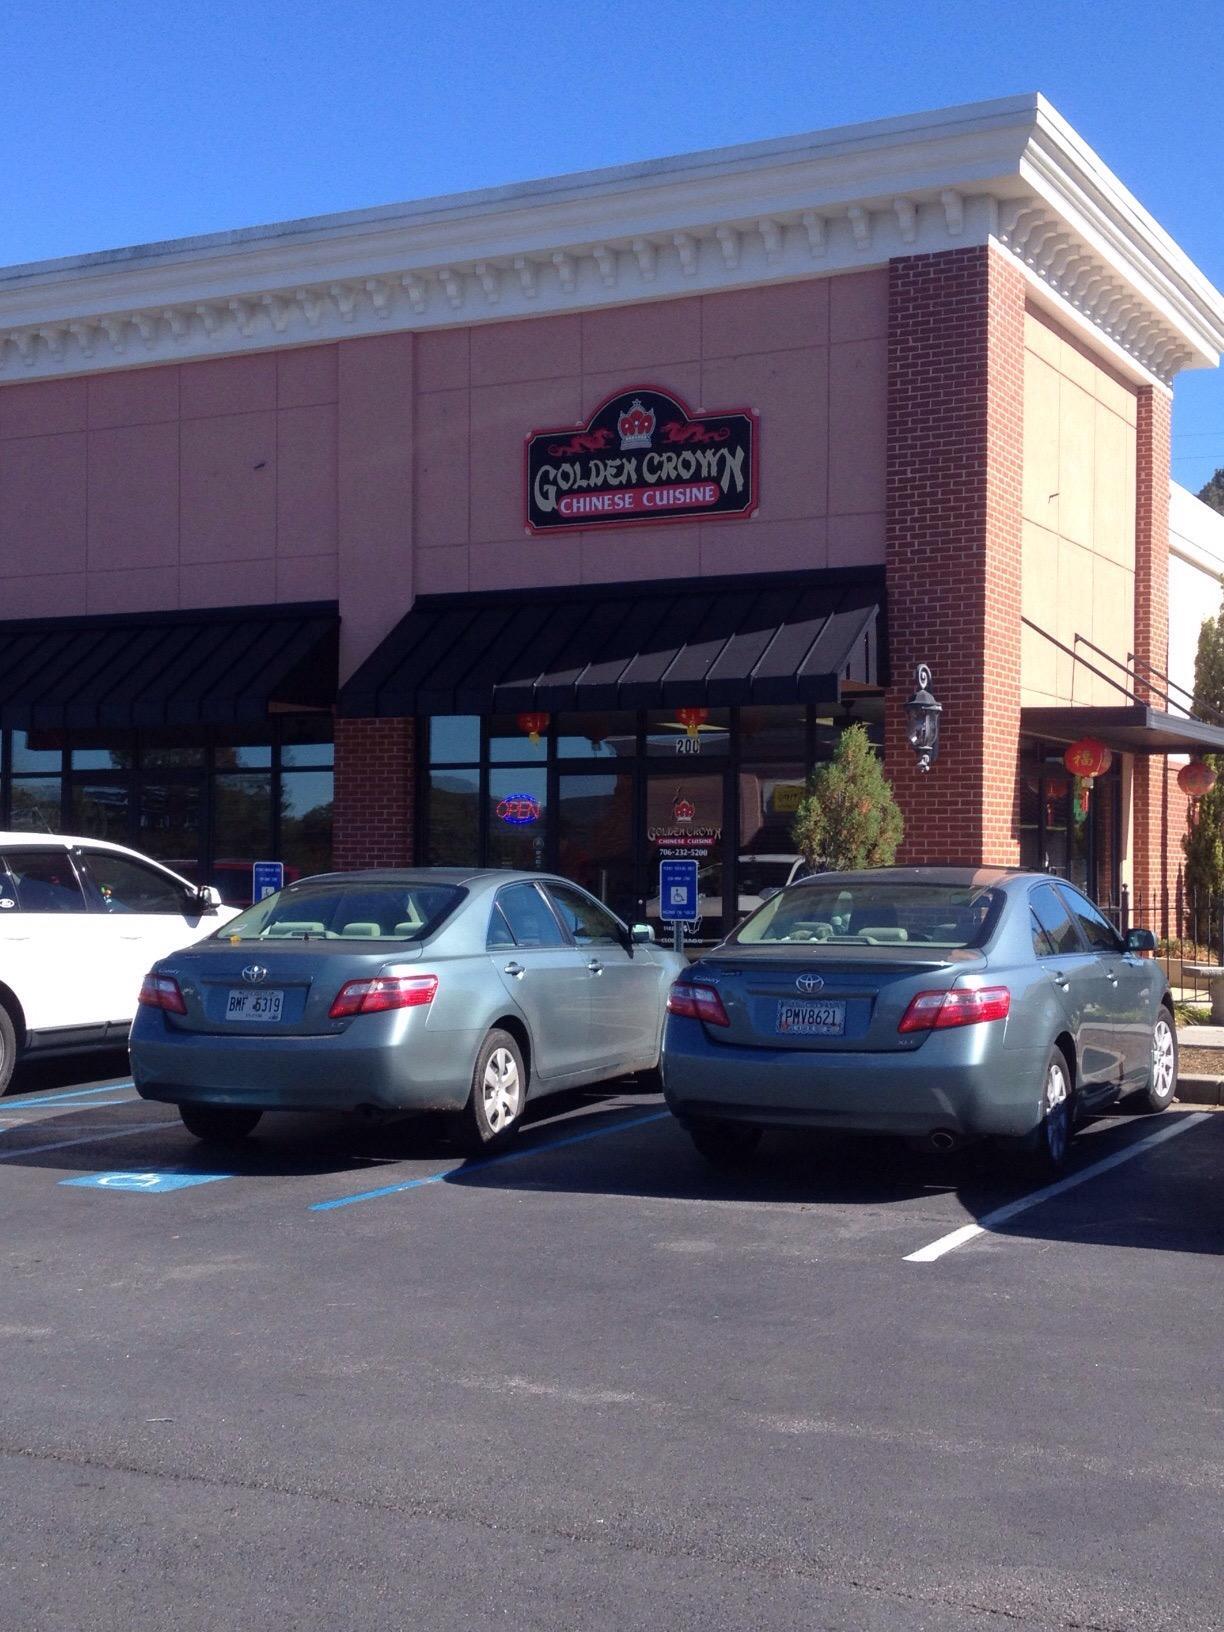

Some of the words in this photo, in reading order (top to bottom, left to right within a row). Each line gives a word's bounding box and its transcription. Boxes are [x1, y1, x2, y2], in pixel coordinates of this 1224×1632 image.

[534, 457, 638, 512] GOLDEN
[642, 445, 745, 494] CROWN
[560, 493, 634, 513] CHINESE
[642, 485, 715, 507] CUISINE
[676, 738, 699, 753] 200
[785, 1008, 837, 1026] PMV8621
